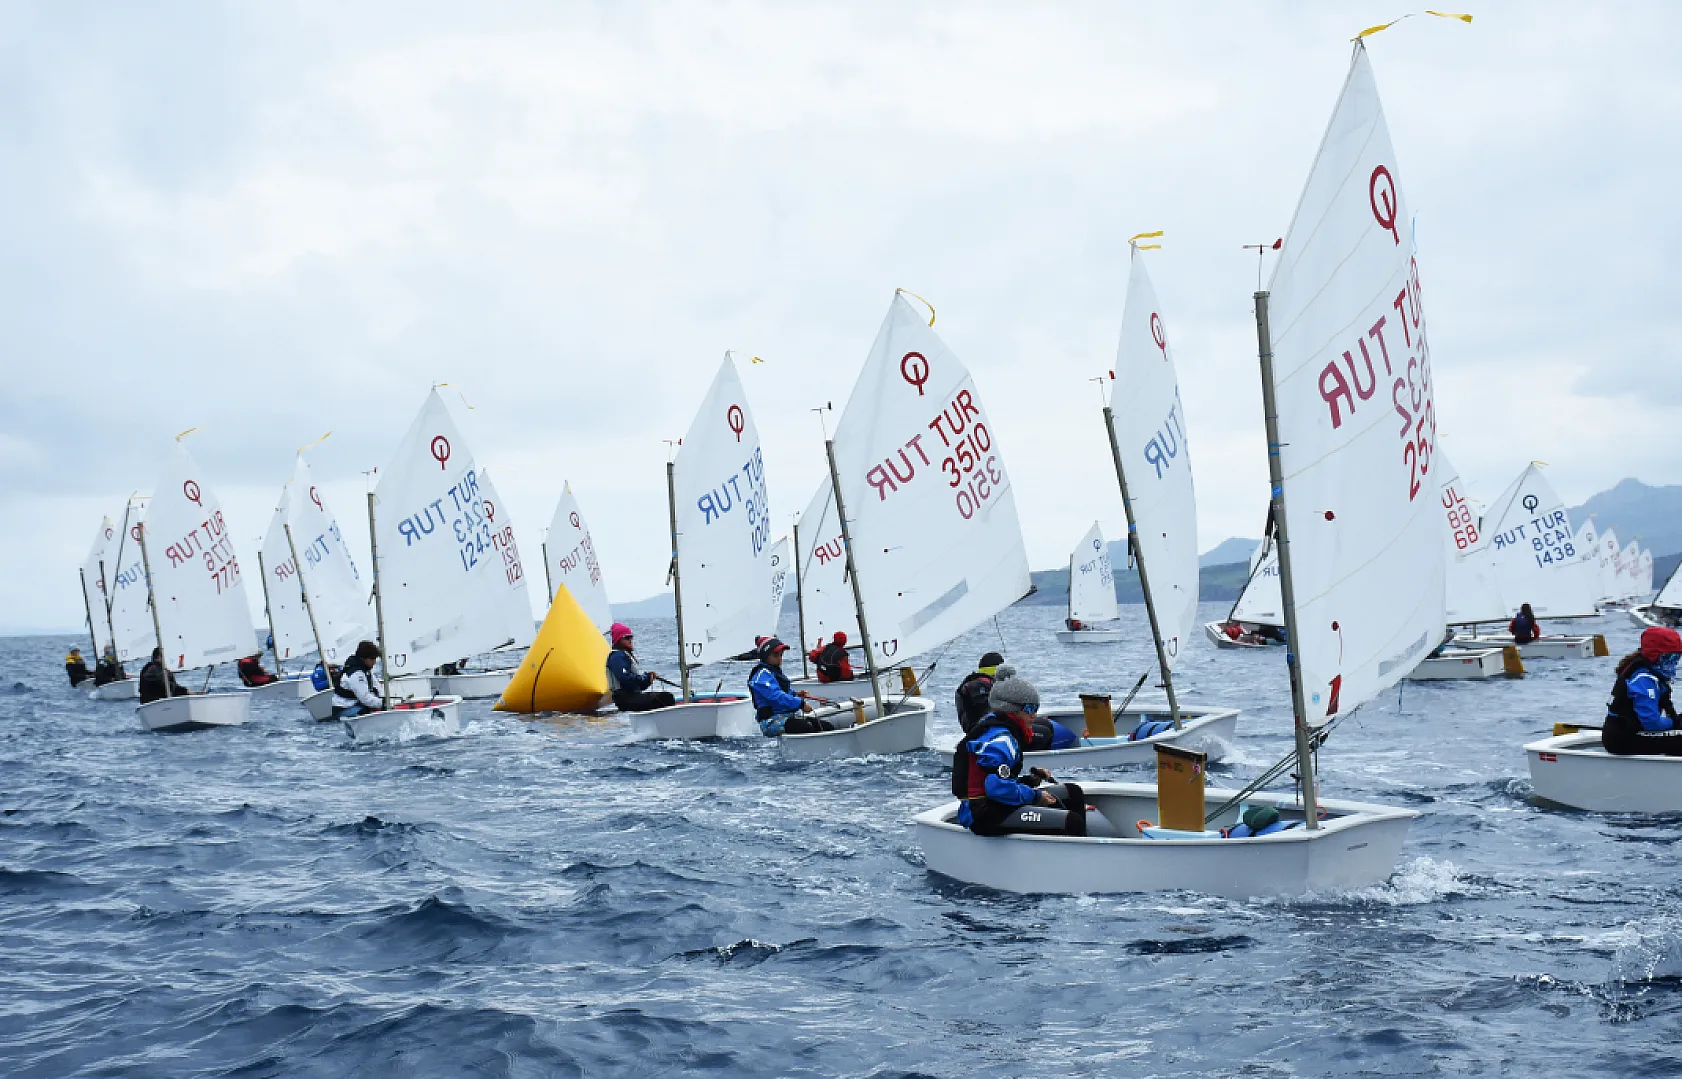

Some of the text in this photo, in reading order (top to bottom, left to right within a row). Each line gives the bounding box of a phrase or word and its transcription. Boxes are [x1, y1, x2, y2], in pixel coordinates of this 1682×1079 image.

[928, 389, 979, 447] TUR
[942, 422, 990, 488] 3510
[448, 469, 479, 511] TUR
[1441, 487, 1465, 509] UL
[201, 511, 226, 541] TUR
[1530, 511, 1566, 533] TUR
[460, 523, 491, 571] 1243
[492, 526, 515, 551] TUR
[1454, 524, 1478, 549] 68
[1535, 543, 1575, 568] 1438
